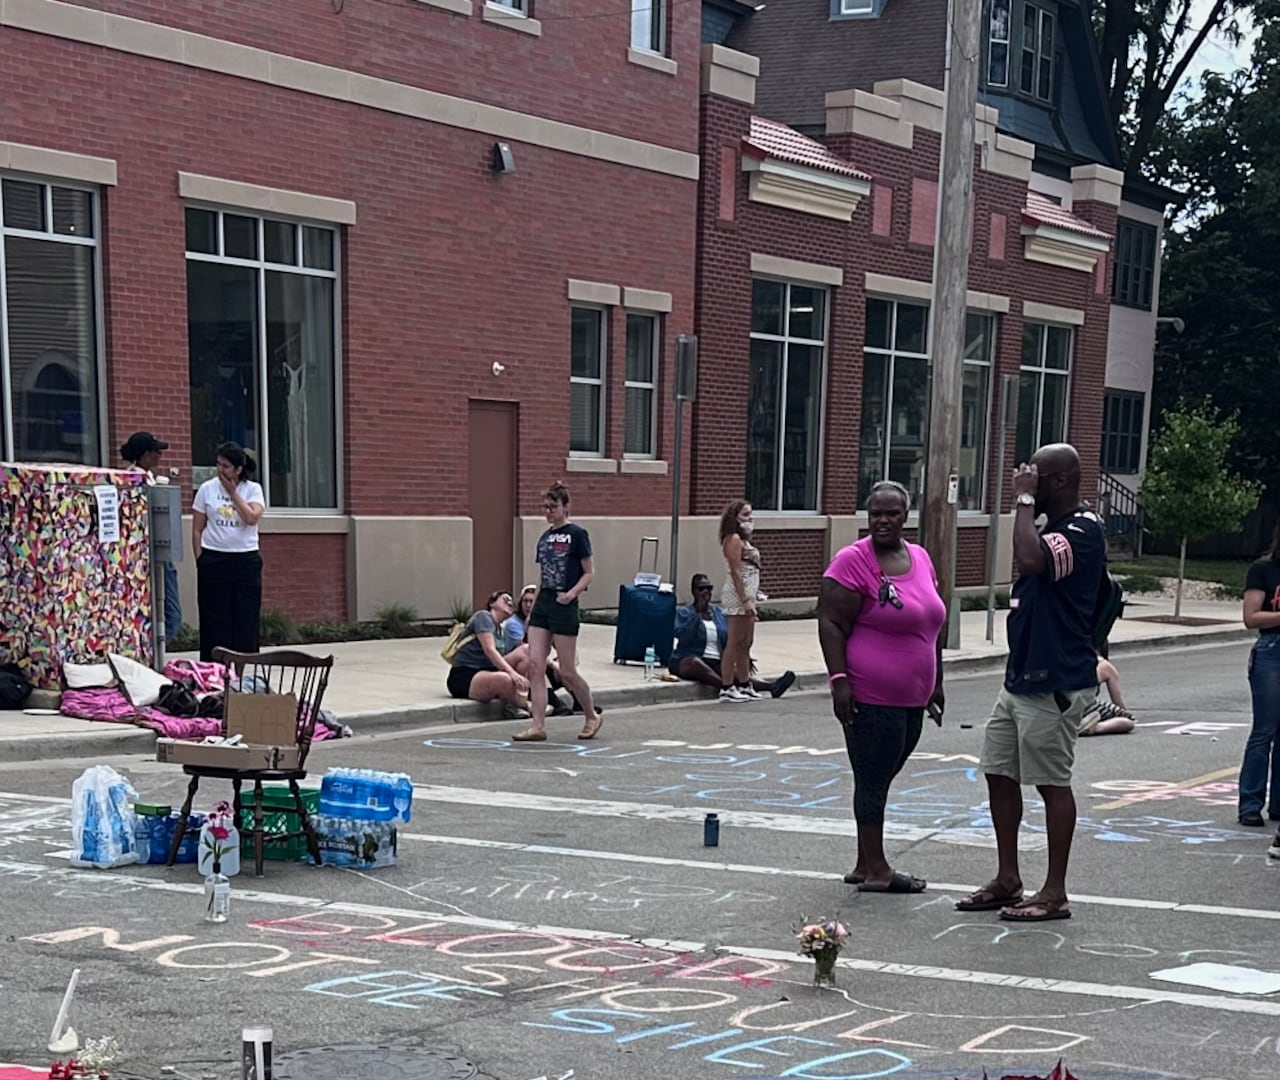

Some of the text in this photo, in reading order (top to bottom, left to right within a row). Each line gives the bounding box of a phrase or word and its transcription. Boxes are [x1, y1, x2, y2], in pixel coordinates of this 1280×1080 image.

[547, 533, 572, 543] NASA
[23, 926, 382, 977] NOT
[250, 908, 790, 983] BLOOD
[303, 970, 914, 1080] BE SHED
